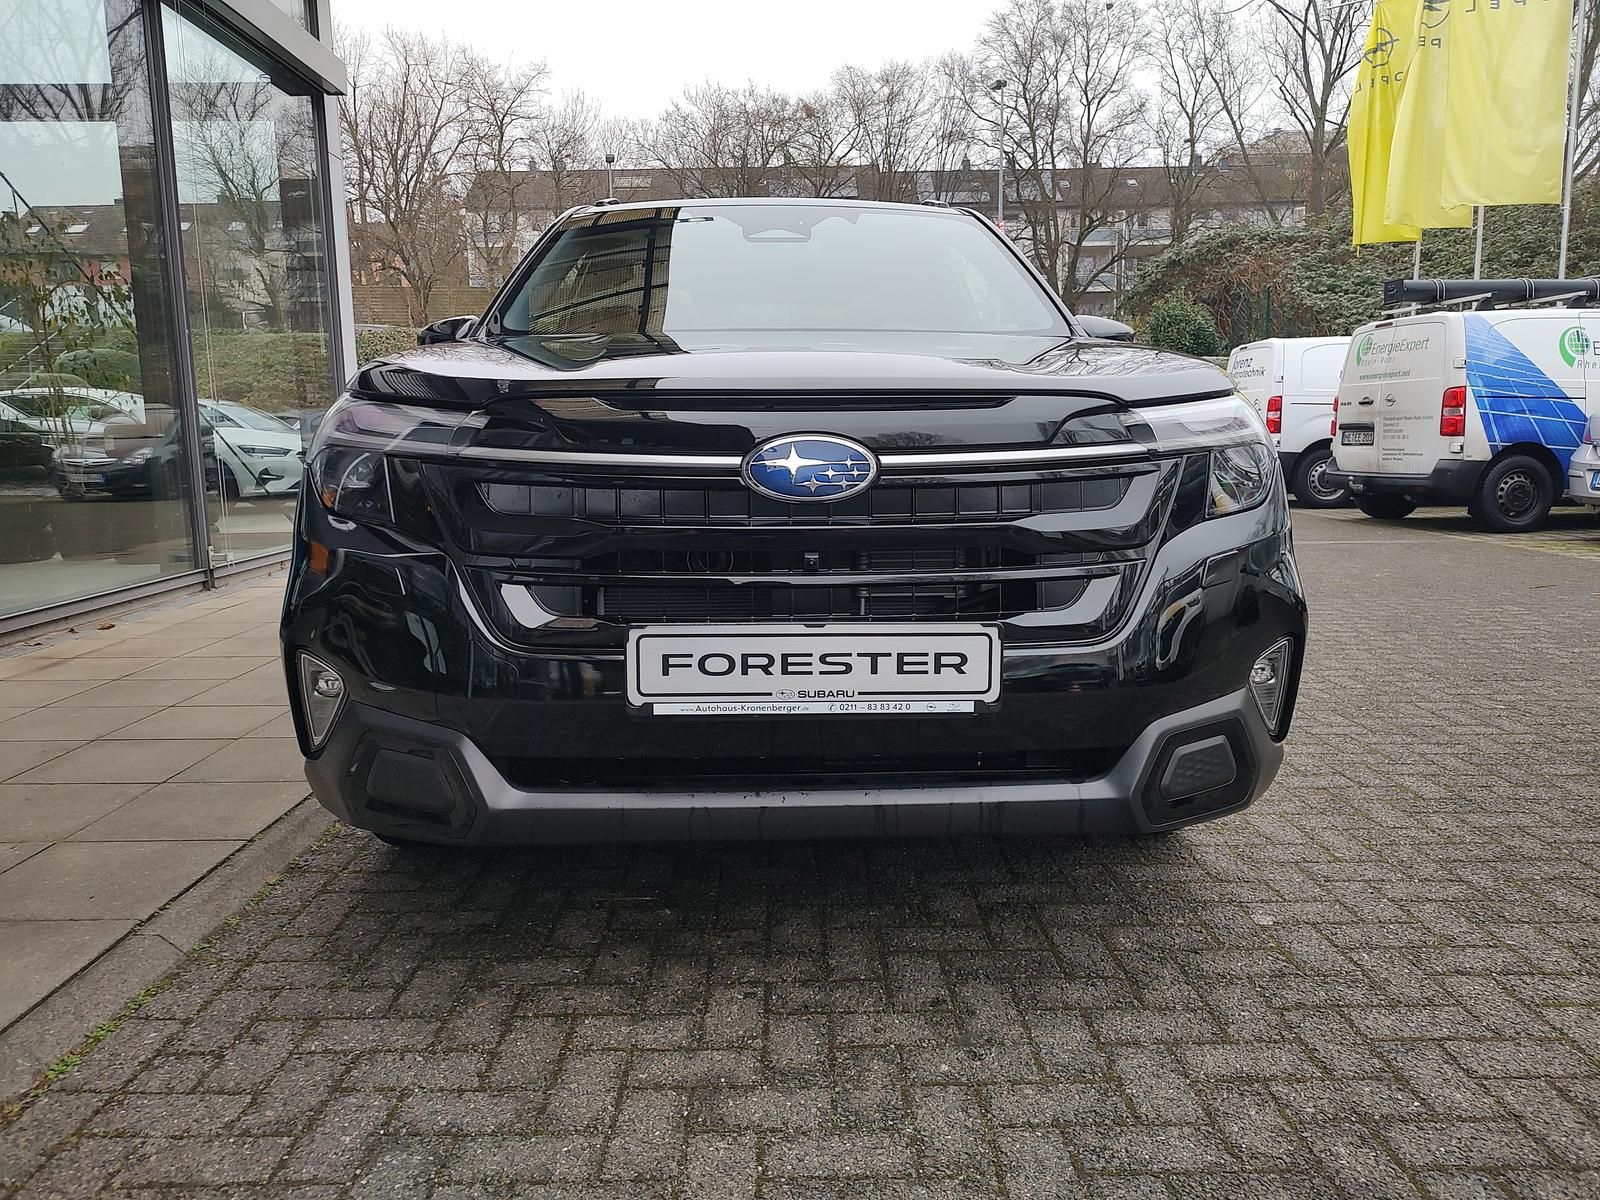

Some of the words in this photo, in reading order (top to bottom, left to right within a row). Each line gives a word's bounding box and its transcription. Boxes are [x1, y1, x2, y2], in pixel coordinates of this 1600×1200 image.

[1371, 336, 1430, 356] EnergieExpert
[1577, 360, 1600, 368] Rhe
[661, 652, 969, 676] FORESTER
[797, 690, 855, 699] SUBARU
[679, 704, 810, 713] www.Autohaus-Kronenberger.de
[839, 703, 857, 711] 0211
[867, 703, 878, 711] 83
[879, 703, 890, 711] 83
[892, 703, 903, 711] 42
